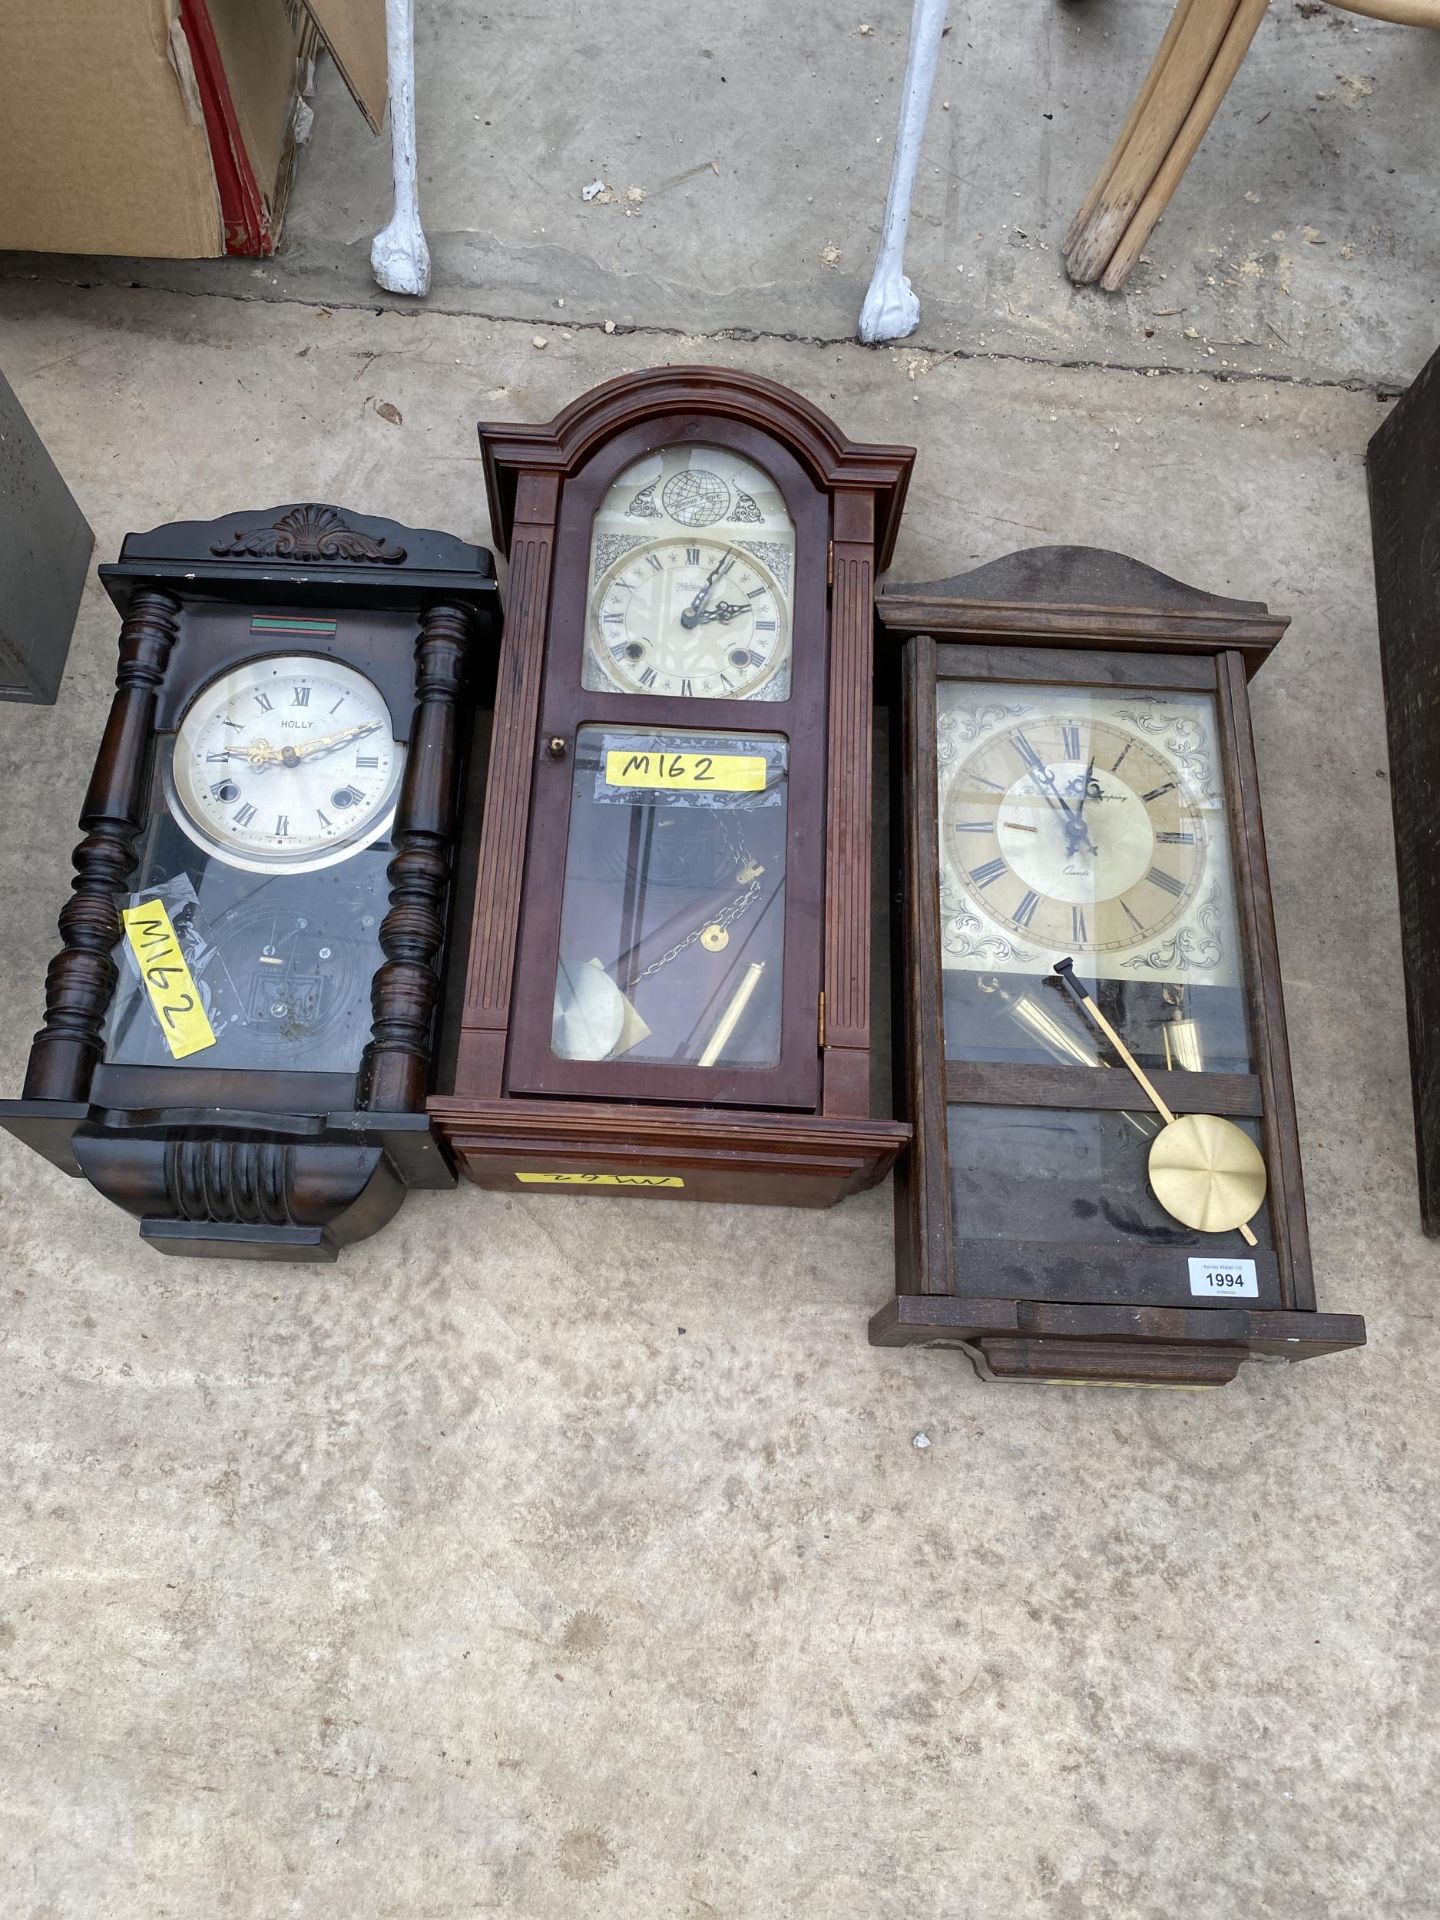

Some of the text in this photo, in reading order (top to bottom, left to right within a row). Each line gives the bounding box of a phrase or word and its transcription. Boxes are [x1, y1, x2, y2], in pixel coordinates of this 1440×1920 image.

[645, 554, 663, 571] XI
[686, 549, 700, 566] XII
[615, 577, 636, 595] X
[746, 586, 766, 599] II
[756, 620, 776, 631] III
[681, 679, 693, 696] VI
[719, 674, 734, 689] V
[254, 693, 274, 714] XI
[291, 687, 312, 707] XII
[329, 697, 345, 715] I
[223, 716, 244, 735] X
[281, 720, 314, 729] HOLLY
[1062, 727, 1080, 760] XII
[356, 756, 379, 769] III
[1111, 743, 1132, 772] I
[622, 755, 715, 781] M162
[1141, 782, 1177, 802] II
[233, 802, 258, 827] VII
[317, 809, 333, 830] V
[275, 815, 290, 836] VI
[1156, 831, 1194, 845] III
[1146, 866, 1187, 898] IIII
[1072, 906, 1087, 942] VI
[129, 920, 194, 1029] M162
[1206, 1273, 1244, 1287] 1994
